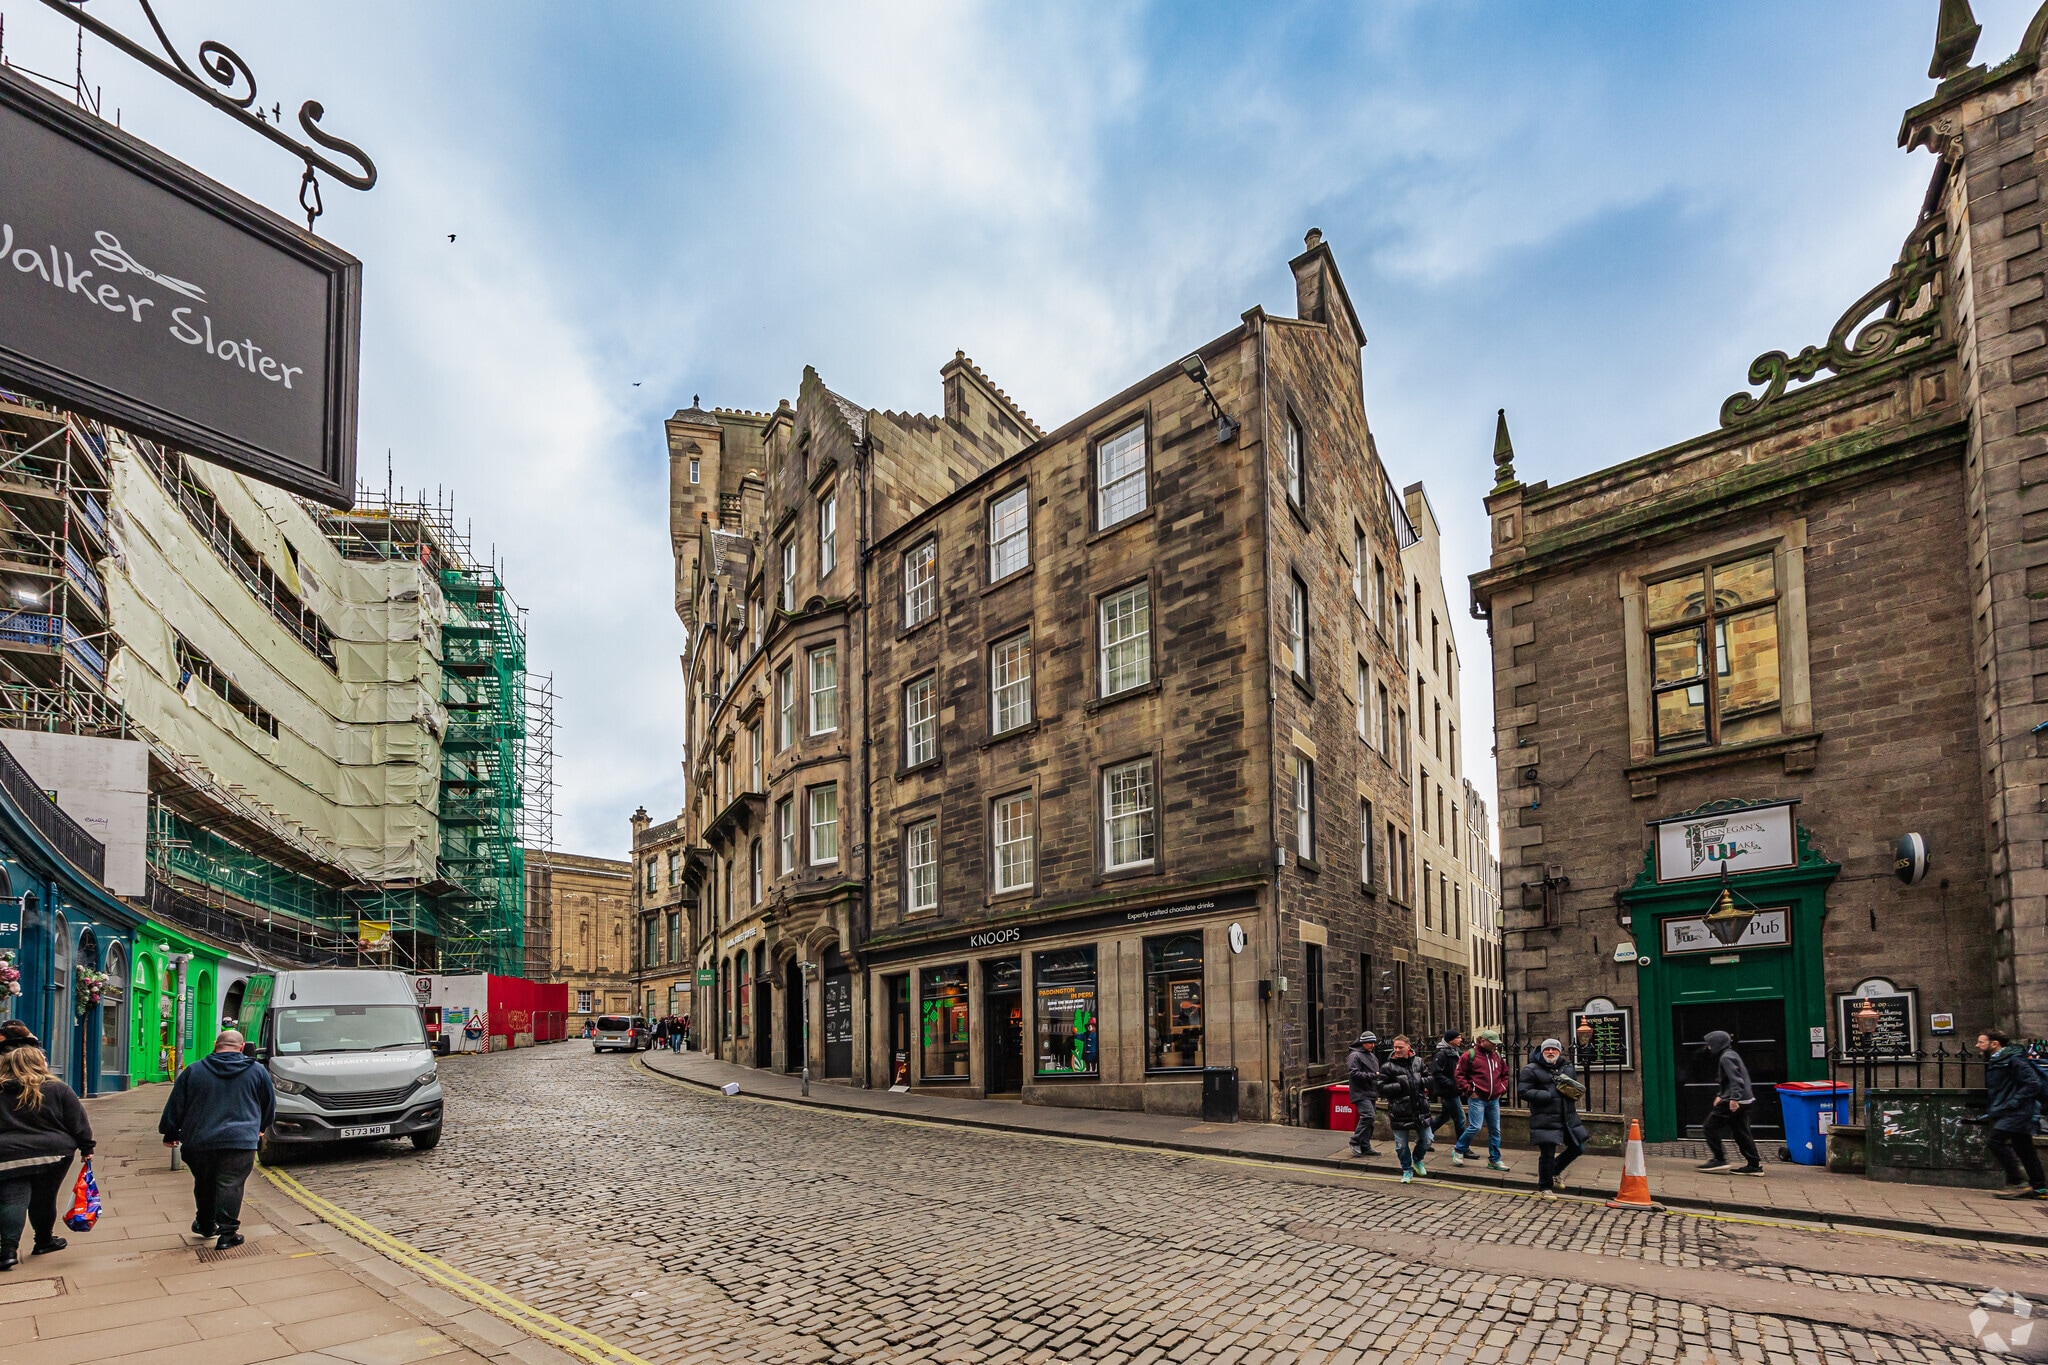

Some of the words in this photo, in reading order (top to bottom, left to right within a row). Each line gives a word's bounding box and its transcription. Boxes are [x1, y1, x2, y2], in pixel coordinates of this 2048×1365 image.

[169, 307, 303, 389] Slater
[1127, 911, 1149, 920] Expertly
[1149, 907, 1168, 916] crafted
[1169, 904, 1196, 913] chocolate
[1197, 901, 1215, 910] drinks
[1750, 917, 1780, 935] Pub
[970, 928, 1020, 948] KNOOPS
[1236, 931, 1242, 946] K
[1038, 987, 1075, 996] PADDINGTON
[1078, 991, 1093, 999] PERU
[1334, 1105, 1352, 1113] Biffa
[344, 1127, 368, 1137] ST73
[369, 1126, 387, 1135] MBY
